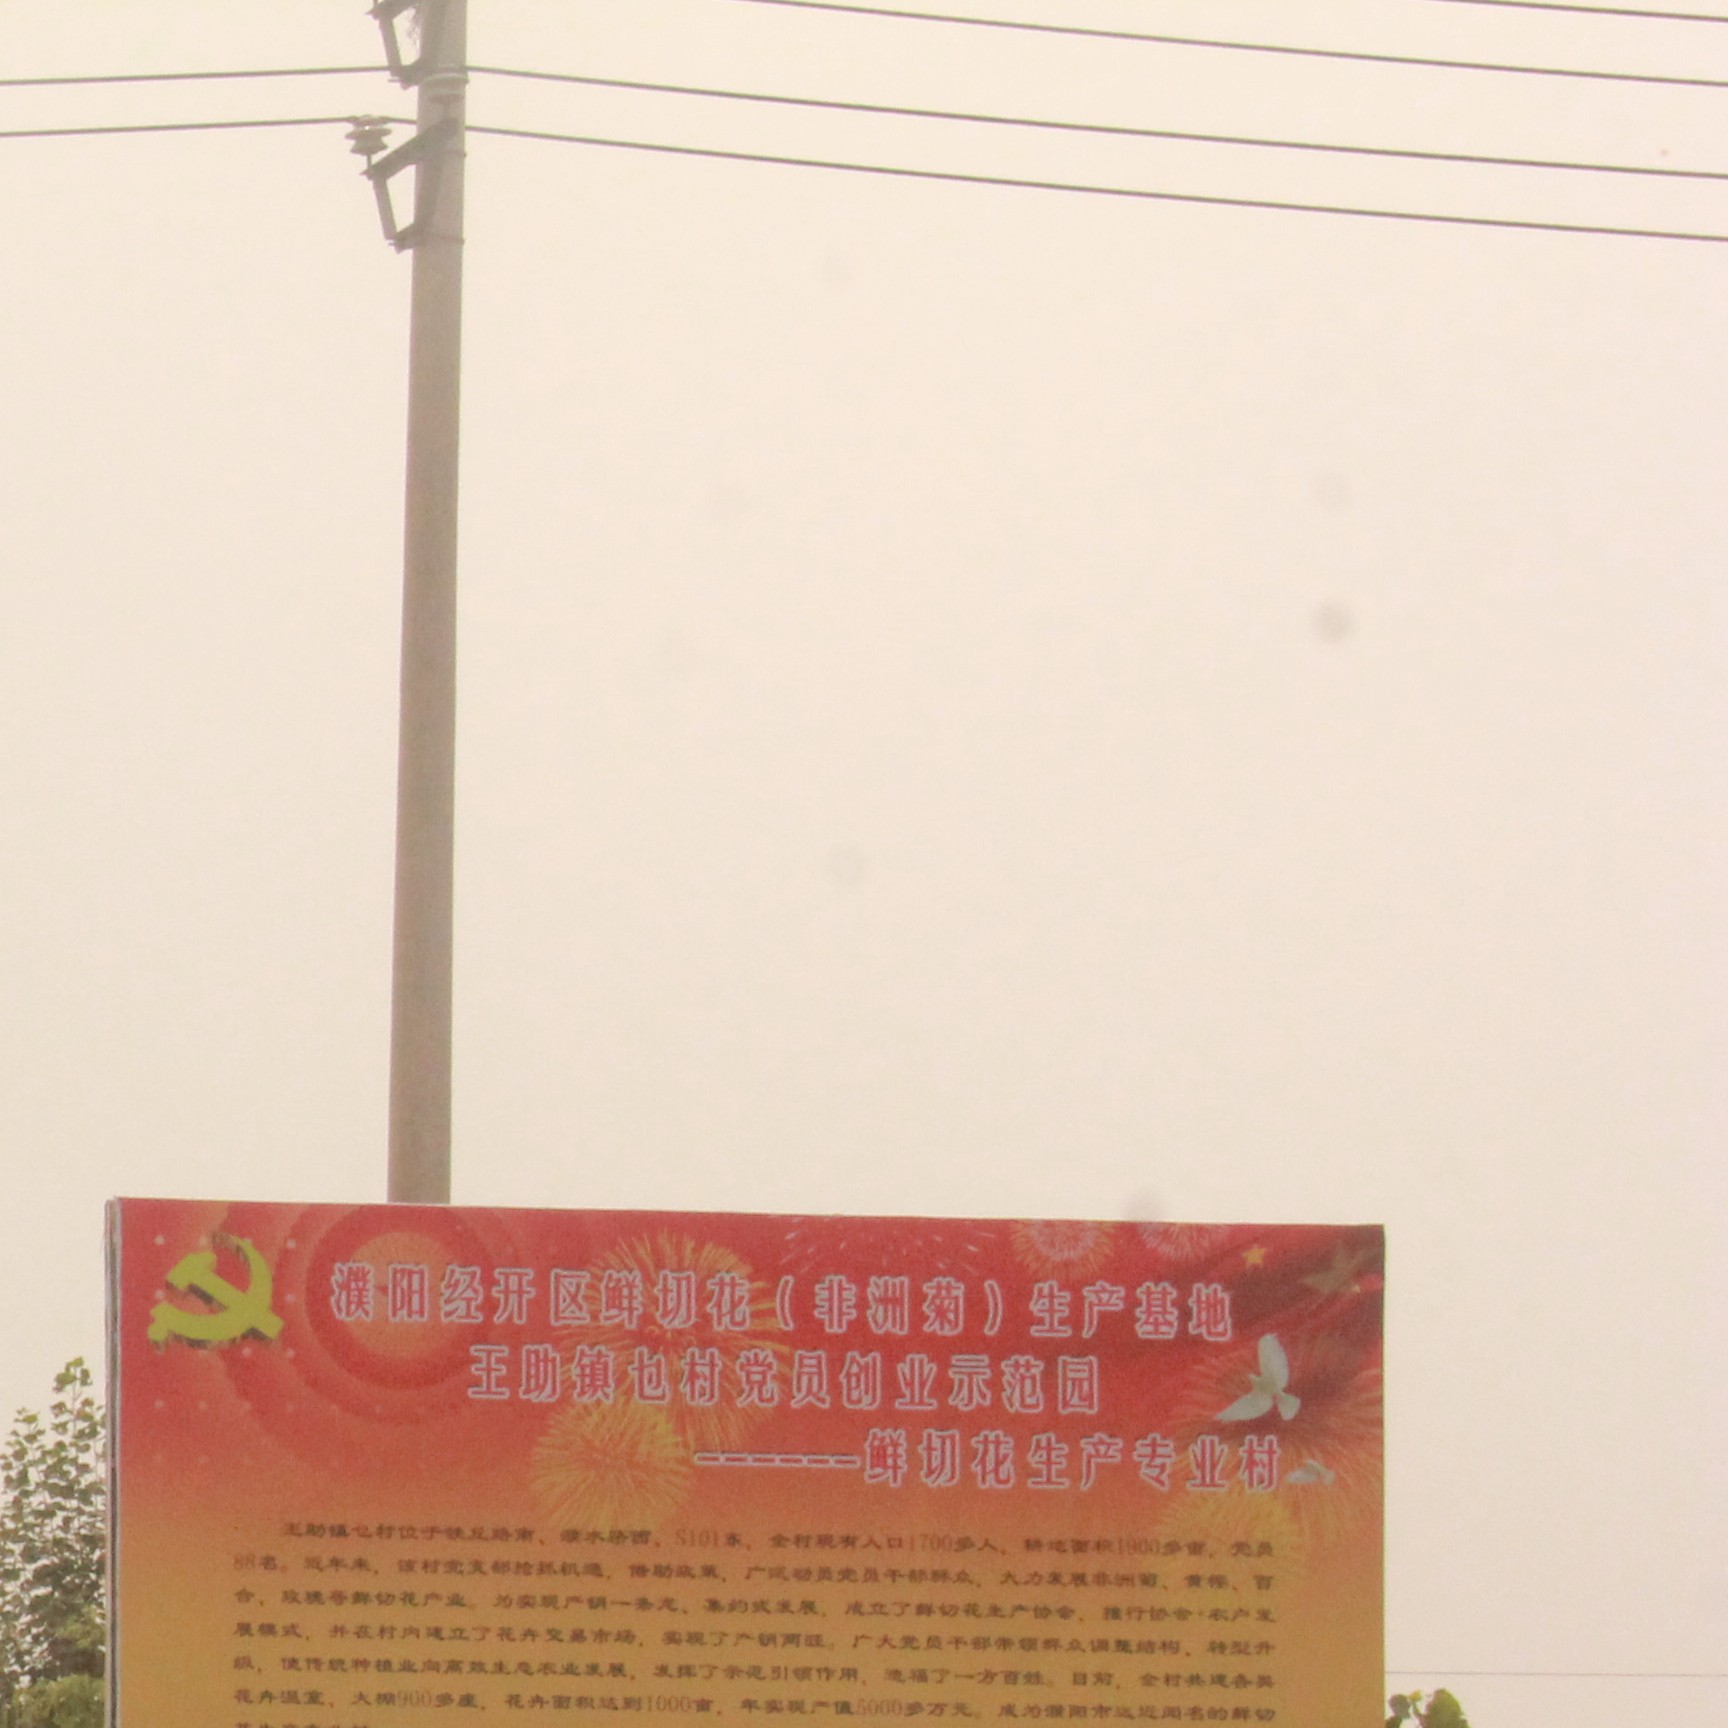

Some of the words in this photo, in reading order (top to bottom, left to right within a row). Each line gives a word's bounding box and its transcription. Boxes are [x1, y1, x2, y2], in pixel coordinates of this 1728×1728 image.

[331, 1261, 1234, 1341] 濮阳经开区鲜切花（非洲菊）生产基地
[467, 1344, 1099, 1415] 王助镇乜村党员创业示范园
